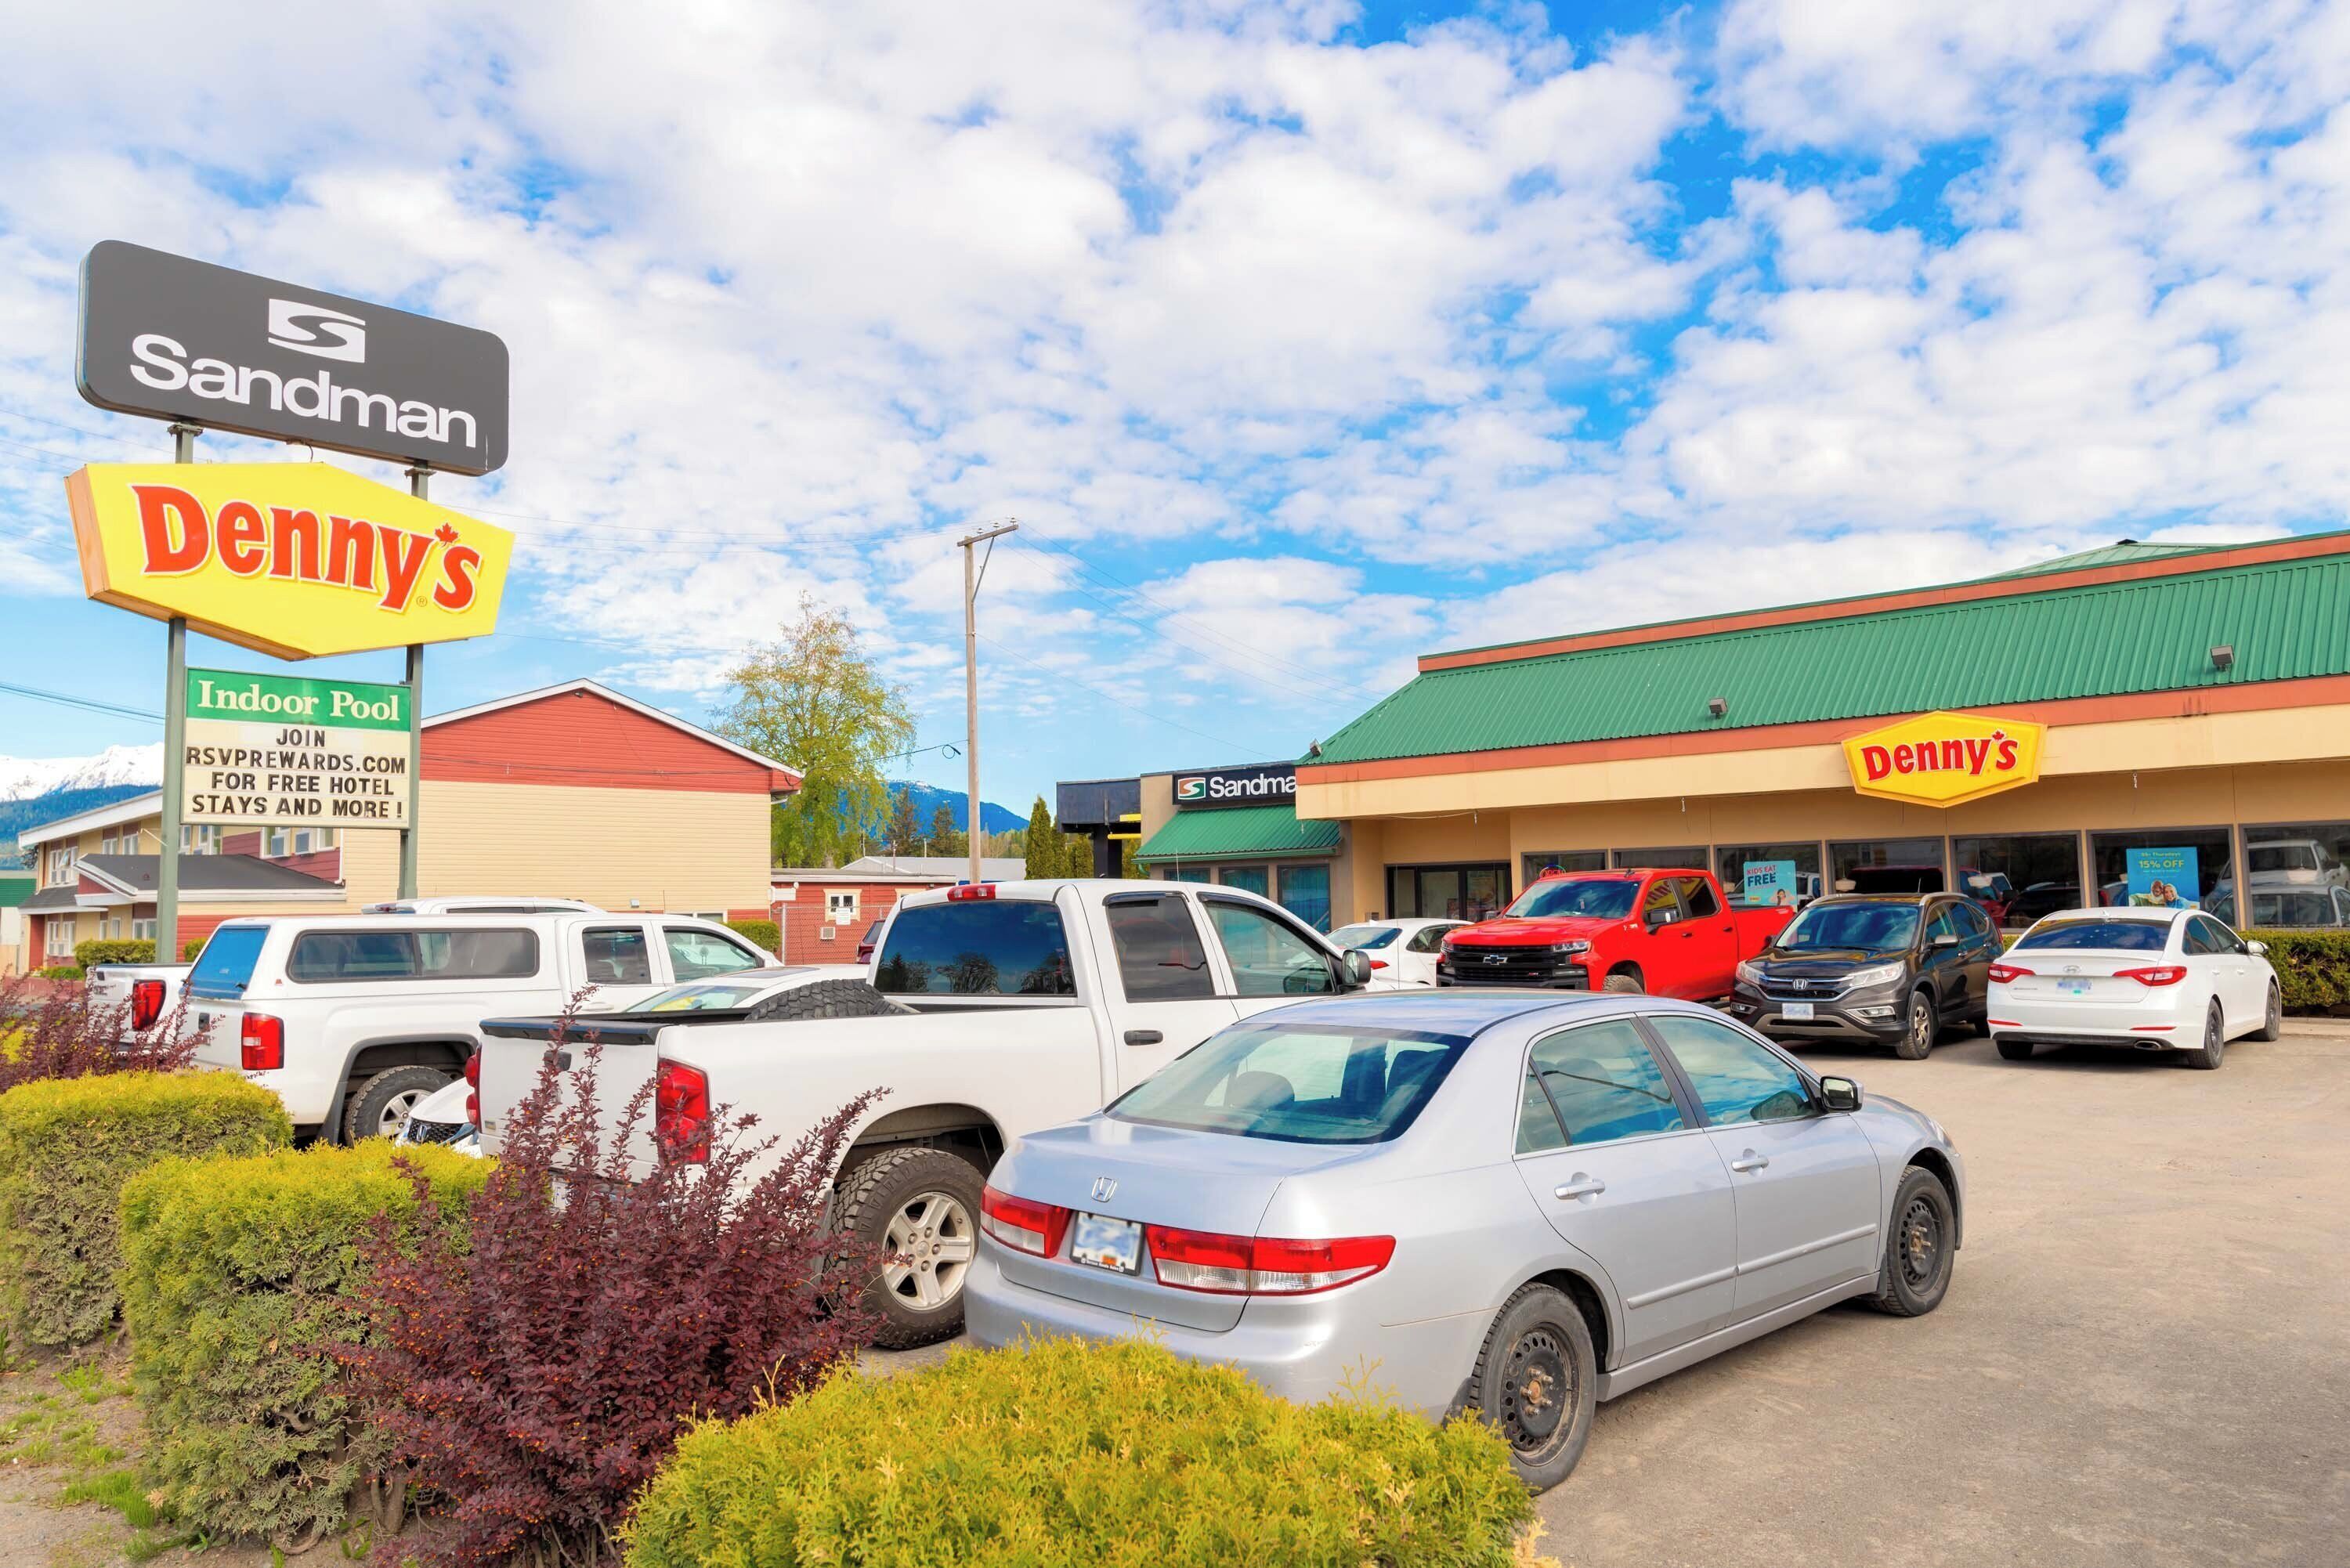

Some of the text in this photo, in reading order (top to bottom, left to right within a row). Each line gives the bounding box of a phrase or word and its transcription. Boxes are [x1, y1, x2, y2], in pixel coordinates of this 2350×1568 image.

[130, 334, 476, 447] Sandman
[128, 483, 481, 614] Denny's
[197, 680, 400, 721] Indoor Pool
[276, 728, 325, 747] JOIN
[186, 746, 406, 774] RSVPREWARDS.COM
[1860, 728, 2019, 782] Denny's
[212, 771, 394, 795] FOR FREE HOTEL
[1209, 773, 1296, 798] Sandma
[192, 794, 267, 815] STAYS
[276, 797, 322, 815] AND
[1746, 867, 1762, 876] KIDS
[2138, 859, 2185, 869] 15% OFF
[1747, 873, 1777, 887] FREE
